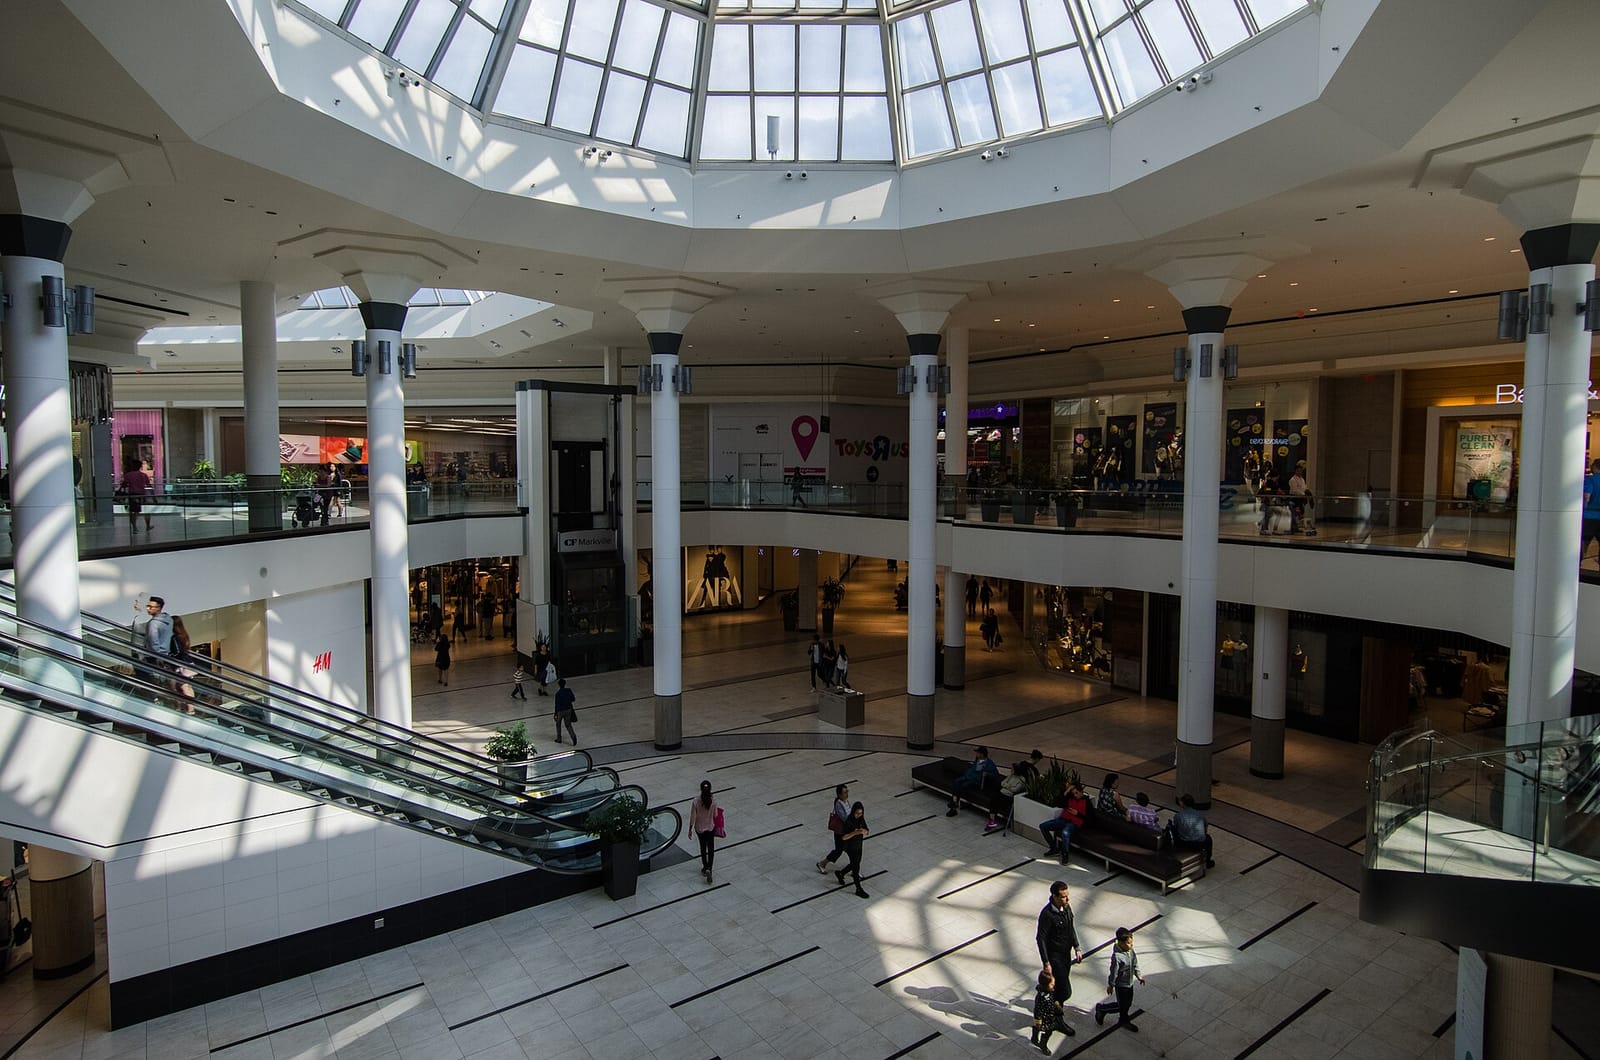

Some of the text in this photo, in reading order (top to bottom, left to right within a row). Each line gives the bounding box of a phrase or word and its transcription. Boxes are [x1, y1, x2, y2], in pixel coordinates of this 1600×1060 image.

[1496, 383, 1524, 405] Ba
[1459, 434, 1498, 442] PURELY
[1460, 442, 1495, 450] CLEAN
[564, 538, 577, 546] CF
[312, 650, 332, 674] H&M
